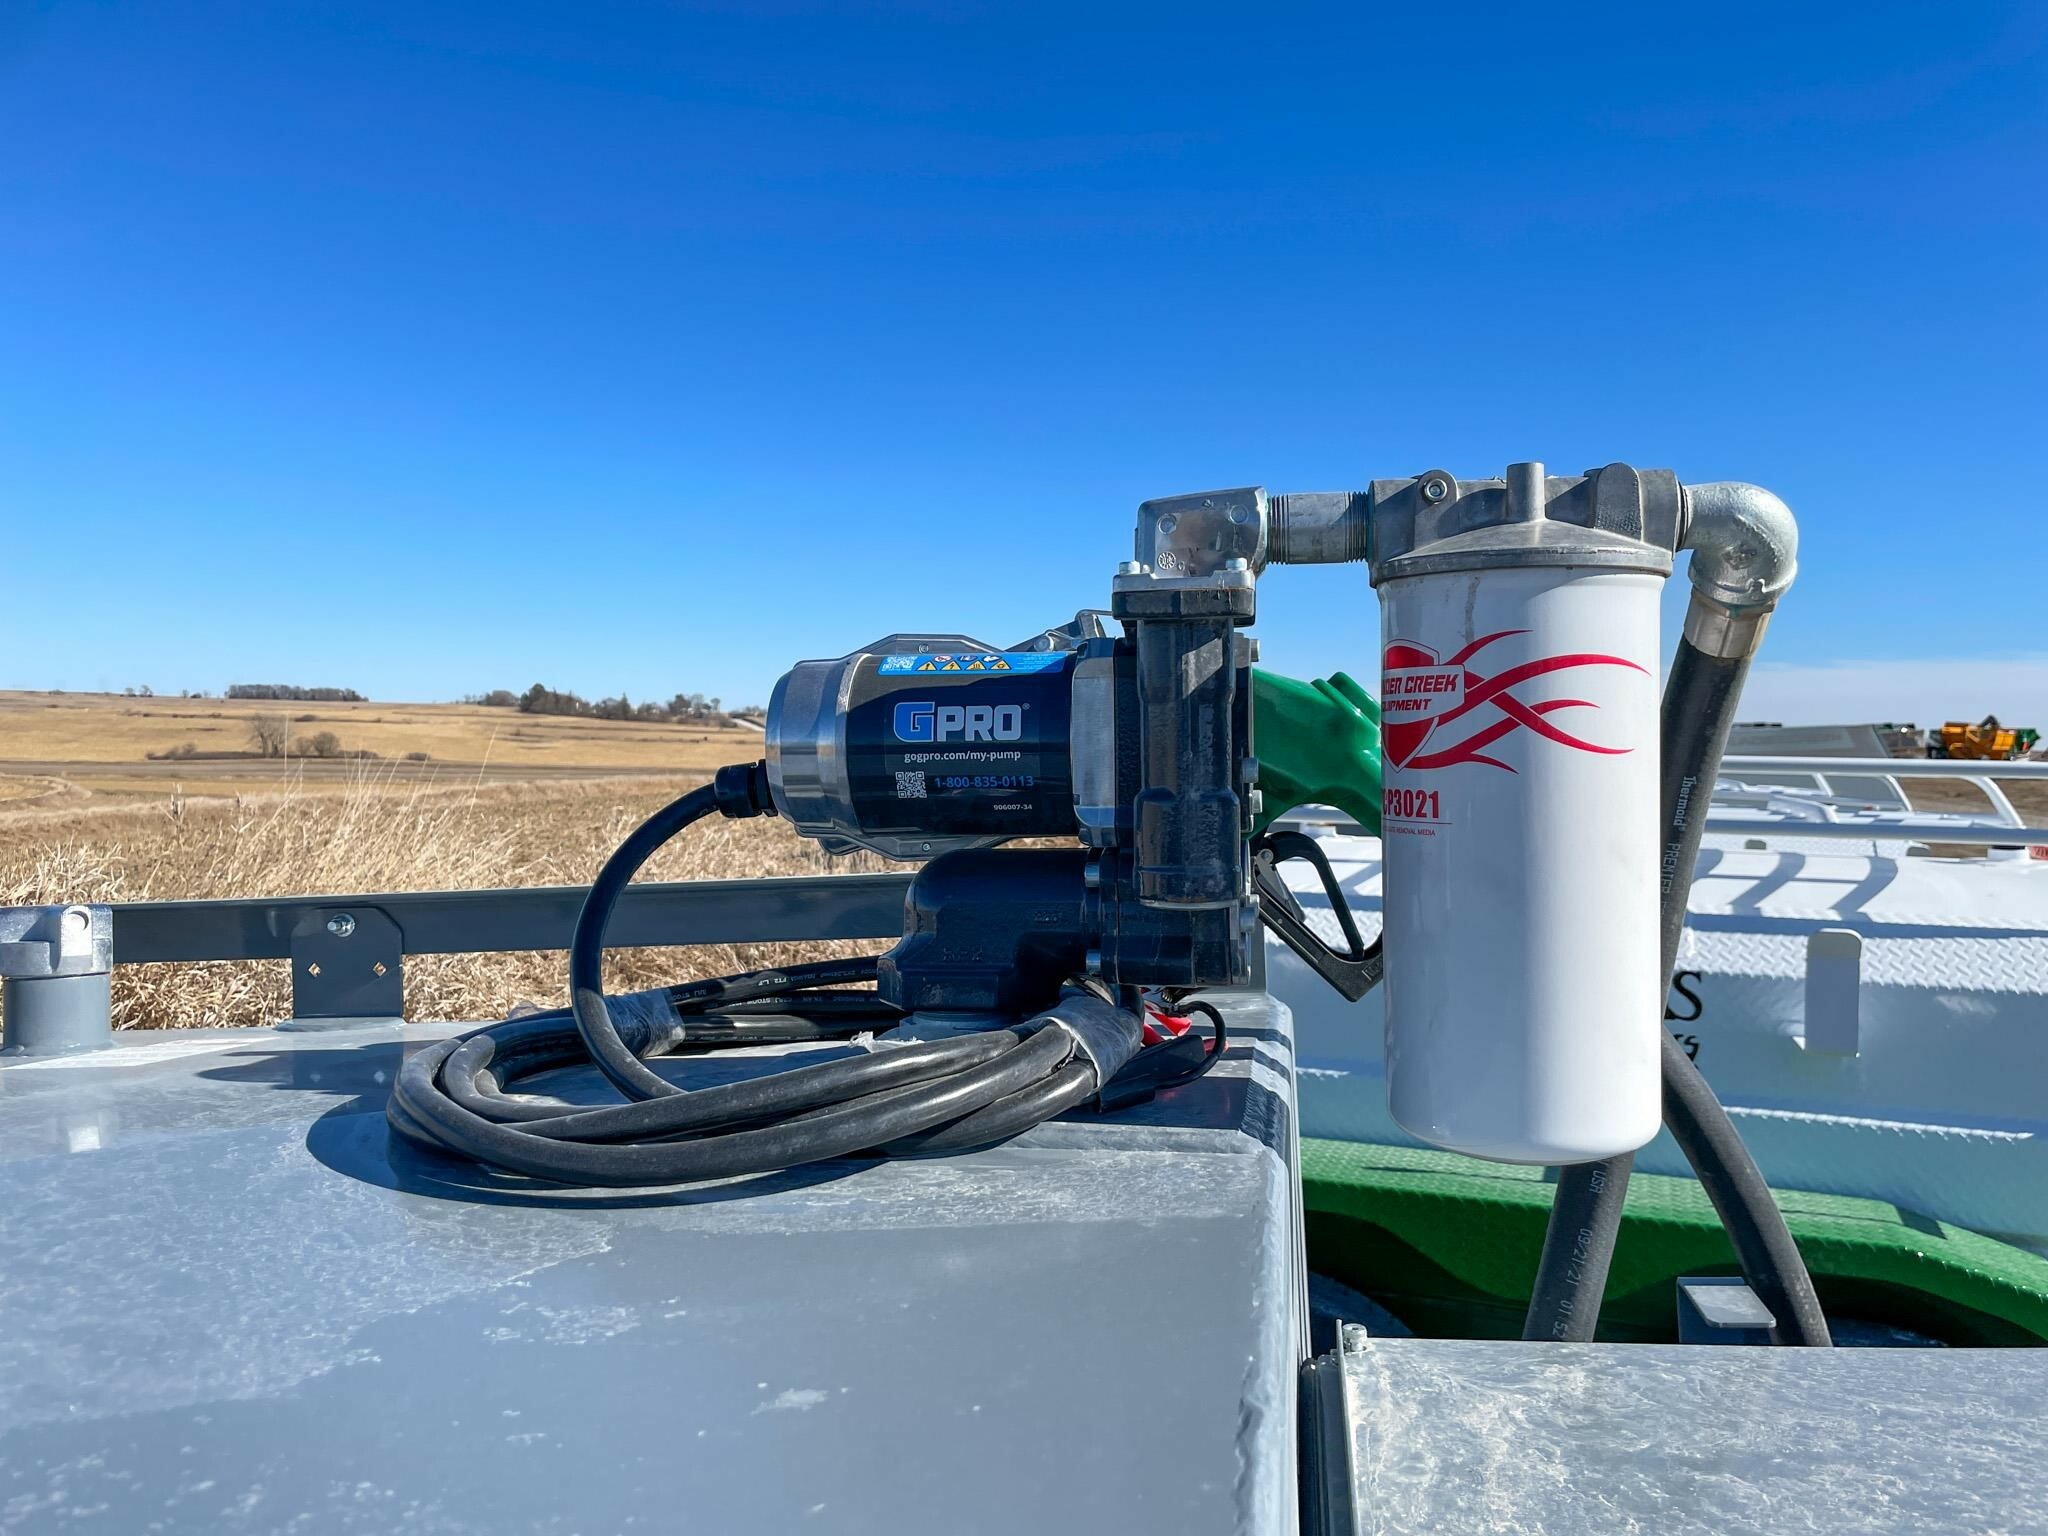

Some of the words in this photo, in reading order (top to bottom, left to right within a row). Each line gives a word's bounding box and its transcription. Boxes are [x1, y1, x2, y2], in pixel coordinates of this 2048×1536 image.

[1404, 674, 1459, 694] CREEK
[904, 750, 1021, 763] gogpro.com/my-pump
[935, 776, 1034, 788] 1-800-835-0113
[1566, 1228, 1593, 1286] 09/21/21
